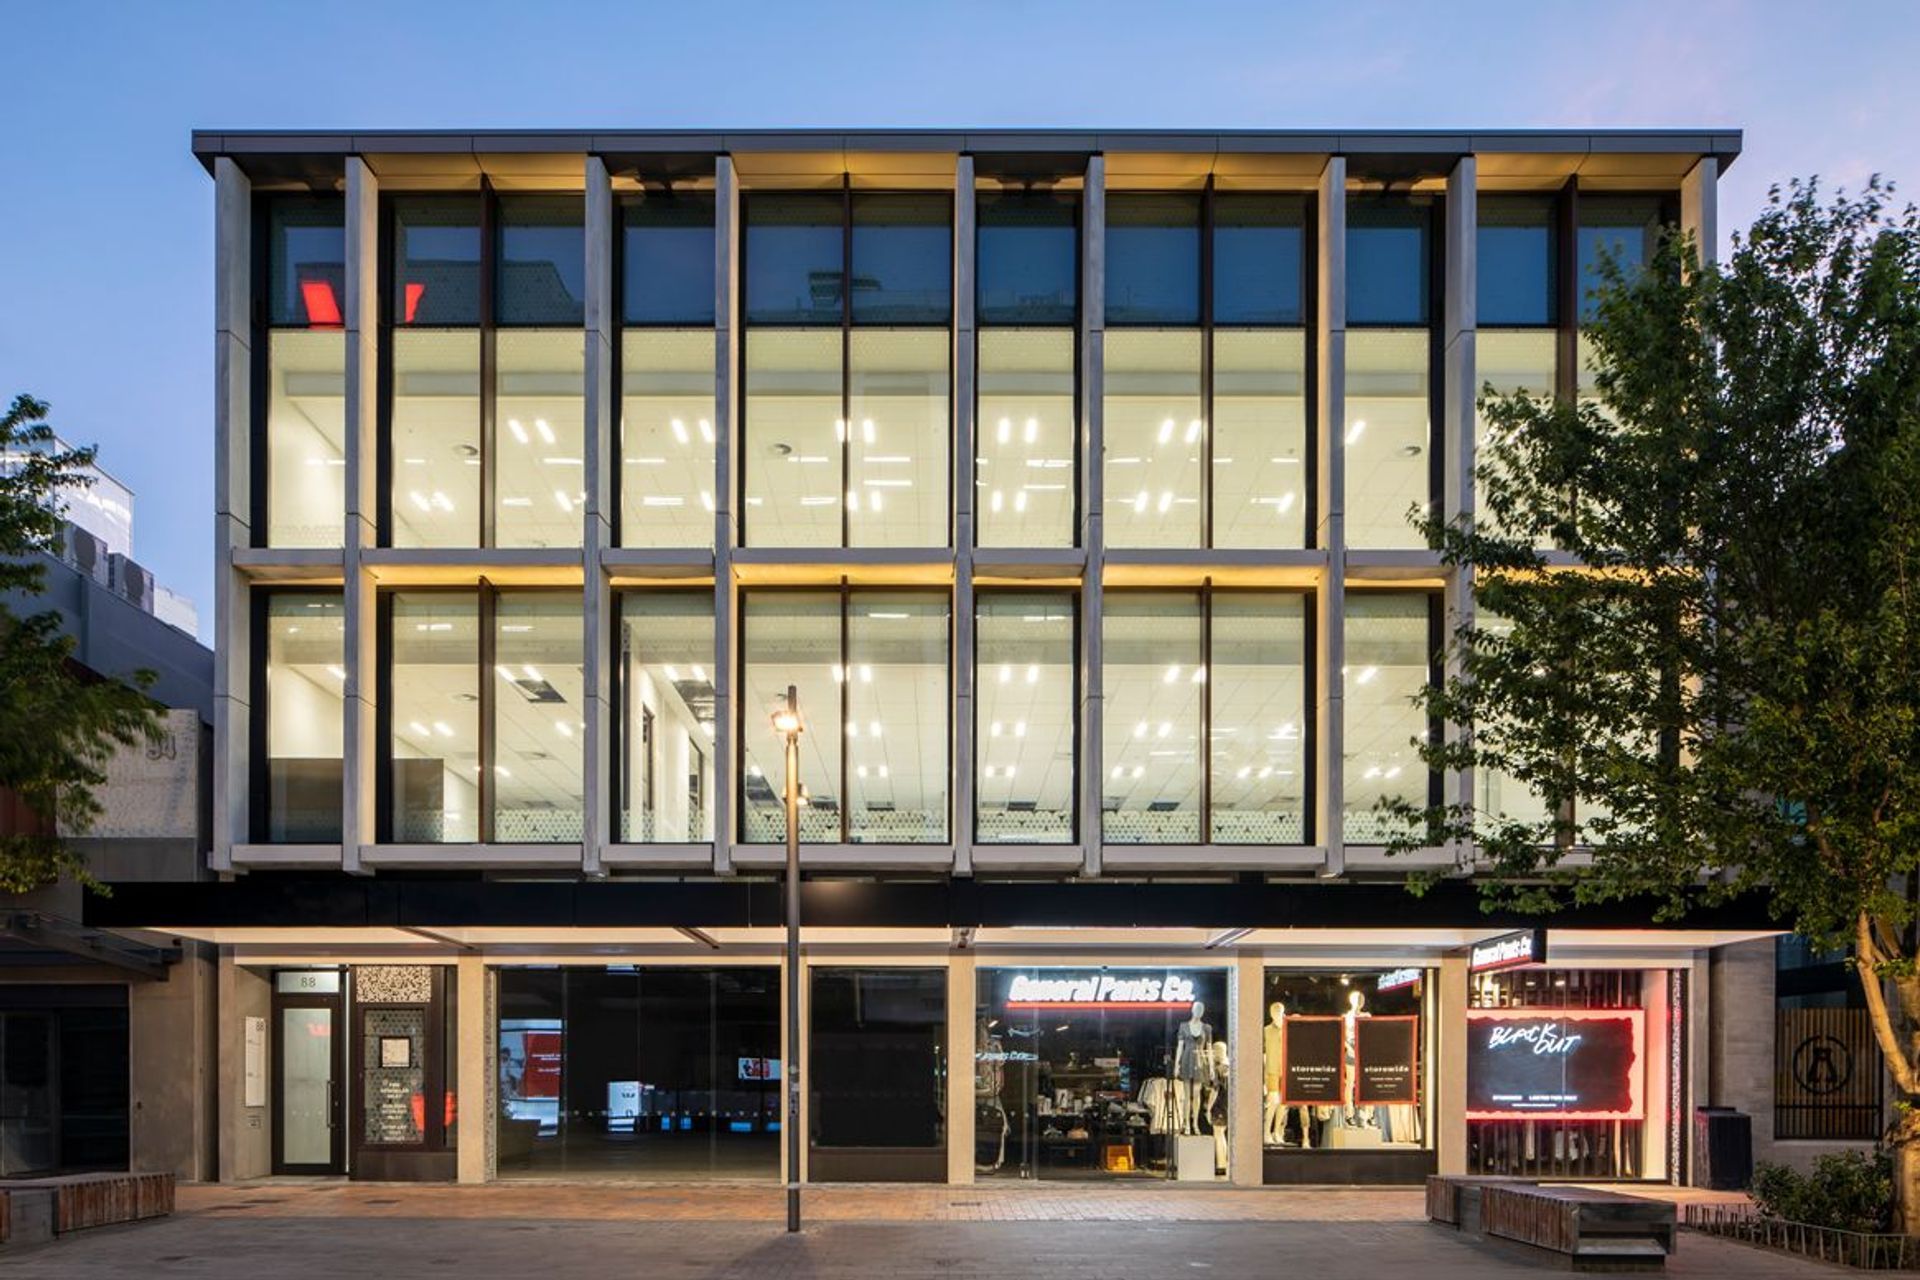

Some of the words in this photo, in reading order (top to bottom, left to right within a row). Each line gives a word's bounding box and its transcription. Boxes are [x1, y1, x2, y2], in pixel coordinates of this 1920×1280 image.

[300, 976, 317, 988] 88
[1009, 976, 1100, 1001] General
[1097, 976, 1162, 1001] Pants
[1488, 1023, 1558, 1049] BLACK
[1533, 1034, 1582, 1055] OUT
[1364, 1065, 1409, 1073] storewide
